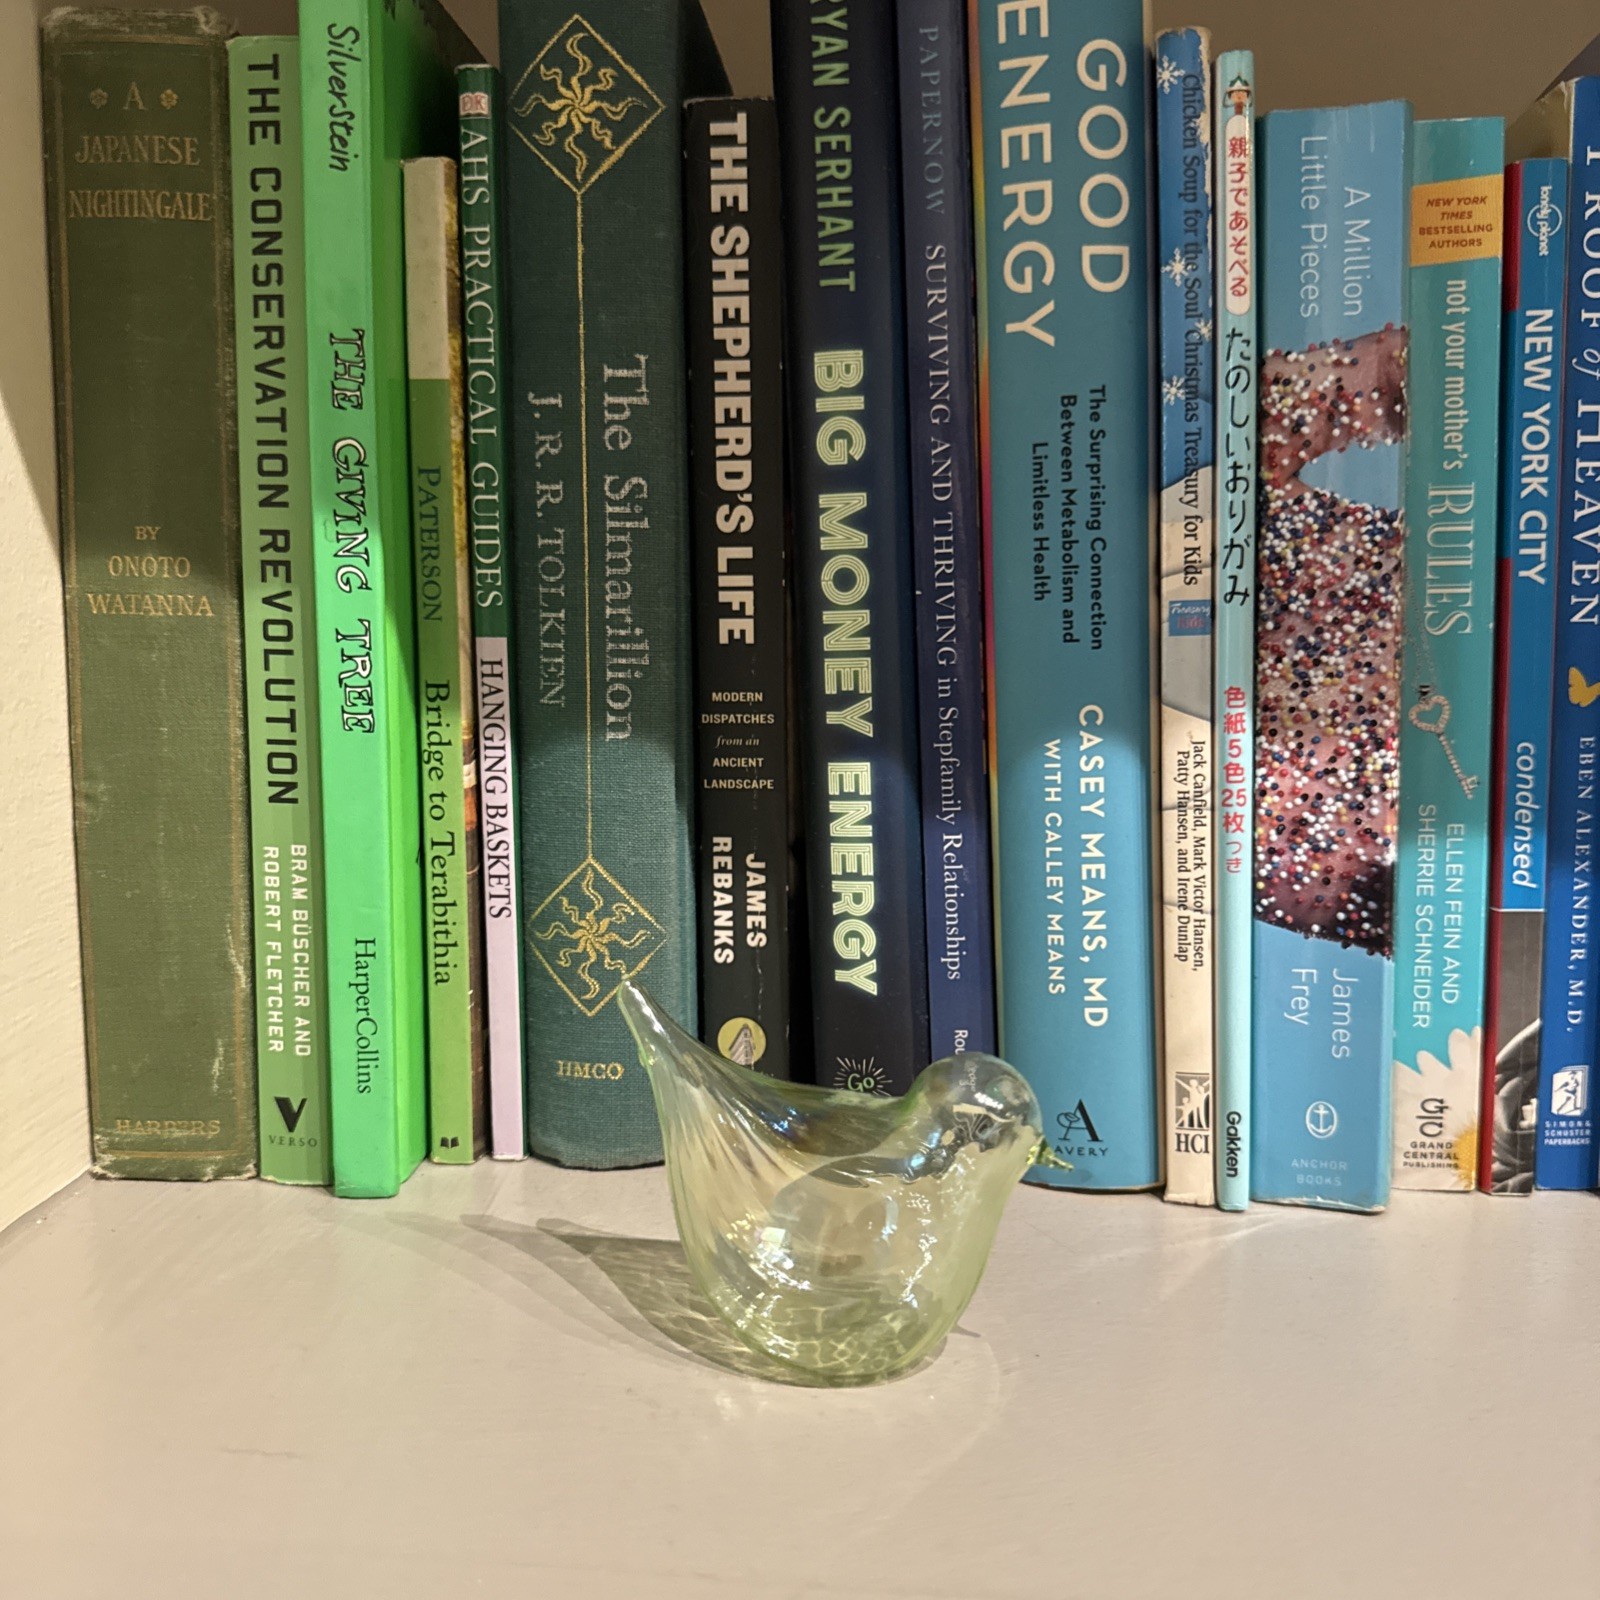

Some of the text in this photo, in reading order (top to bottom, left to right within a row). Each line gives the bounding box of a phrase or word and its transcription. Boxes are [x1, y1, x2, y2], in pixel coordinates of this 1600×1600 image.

[75, 135, 200, 166] JAPANESE
[122, 81, 149, 111] A
[327, 23, 362, 172] Silverstein
[810, 0, 855, 292] YAN SERHANT
[919, 25, 945, 215] PAPERNOW
[1076, 39, 1130, 293] GOOD
[68, 189, 215, 221] NIGHTINGALE
[997, 0, 1055, 347] ENERGY
[1227, 136, 1249, 297] 親子であそべる
[1300, 136, 1327, 318] Little Pieces
[1418, 224, 1493, 236] BESTSELLING
[1426, 195, 1488, 208] NEW YORK
[1428, 238, 1483, 249] AUTHORS
[1440, 211, 1473, 221] TIMES
[1536, 186, 1552, 219] lonely
[1537, 221, 1551, 256] planet
[1343, 187, 1371, 316] A Million
[461, 129, 503, 608] AHS PRACTICAL GUIDES
[709, 112, 755, 644] THE SHEPHERD'S LIFE
[1179, 75, 1203, 585] Chicken Soup for the Soul Christmas Treasury for Kids
[1441, 279, 1470, 470] not your mother's
[1572, 348, 1600, 381] of
[247, 53, 299, 803] THE CONSERVATION REVOLUTION
[1223, 328, 1252, 606] たのしいおりがみ
[1517, 309, 1554, 586] NEW YORK CITY
[108, 555, 192, 579] ONOTO
[134, 526, 161, 541] BY
[329, 328, 375, 733] THE GIVING TREE
[417, 465, 443, 622] PATERSON
[527, 391, 566, 708] J. R. R. TOLKIEN
[603, 353, 650, 741] The Silmarillion
[1031, 442, 1052, 601] Limitless Health
[1060, 395, 1080, 643] Between Metabolism and
[1085, 384, 1107, 650] The Surprising Connection
[1424, 482, 1475, 636] RULES
[1570, 398, 1600, 625] HEAVEN
[87, 593, 215, 617] WATANNA
[814, 349, 878, 996] BIG MONEY ENERGY
[925, 244, 964, 980] SURVIVING AND THRIVING in Stepfamily Relationships
[701, 713, 775, 725] DISPATCHES
[711, 691, 763, 702] MODERN
[712, 757, 764, 768] ANCIENT
[716, 735, 760, 748] from an
[422, 680, 459, 986] Bridge to Terabithia
[480, 658, 512, 919] HANGING BASKETS
[703, 779, 775, 790] LANDSCAPE
[1173, 751, 1191, 962] Patty Hansen, and Irene Dunlap
[1190, 741, 1207, 971] Jack Canfield, Mark Victor Hansen,
[1512, 741, 1540, 889] condensed
[712, 836, 734, 964] REBANKS
[745, 854, 767, 948] JAMES
[1043, 738, 1065, 994] WITH CALLEY MEANS
[1078, 704, 1109, 1027] CASEY MEANS, MD
[1412, 804, 1437, 1028] SHERRIE SCHNEIDER
[1441, 823, 1465, 1004] ELLEN FEIN AND
[1566, 736, 1596, 1032] EBEN ALEXANDER, M.D.
[263, 847, 284, 1052] ROBERT FLETCHER
[291, 844, 312, 1056] BRAM BÜSCHER AND
[349, 937, 379, 1095] HarperCollins
[1284, 967, 1317, 1026] Frey
[1331, 967, 1359, 1060] James
[115, 1119, 222, 1136] HARPERS
[268, 1134, 318, 1147] VERSO
[1055, 1146, 1108, 1157] AVERY
[1175, 1133, 1209, 1154] HCI
[1226, 1111, 1241, 1178] Gakken
[1291, 1158, 1348, 1170] ANCHOR
[1296, 1174, 1342, 1186] BOOKS
[1403, 1151, 1459, 1160] CENTRAL
[1410, 1141, 1453, 1149] GRAND
[1544, 1129, 1591, 1137] SCHUSTER
[1545, 1120, 1583, 1128] SIMON
